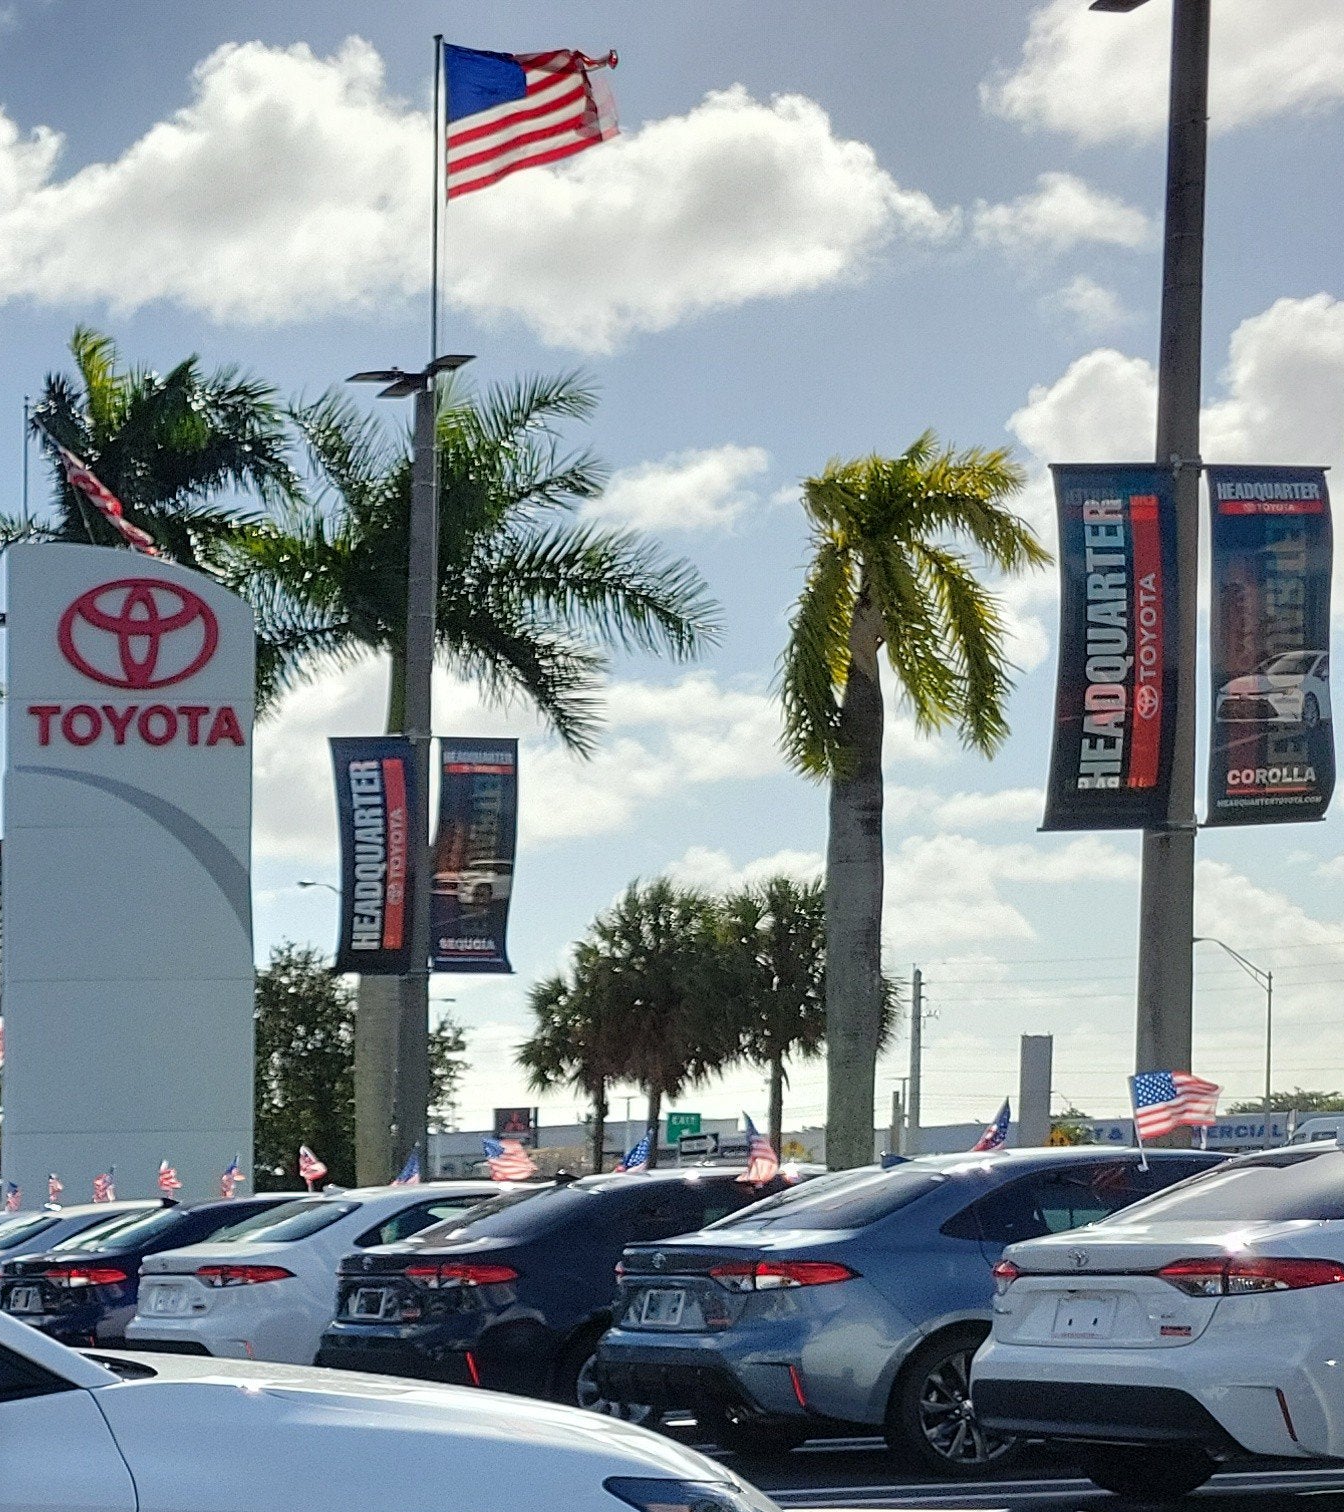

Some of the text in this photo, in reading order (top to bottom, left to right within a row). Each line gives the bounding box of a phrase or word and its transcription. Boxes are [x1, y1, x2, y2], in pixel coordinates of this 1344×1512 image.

[1216, 482, 1320, 501] HEADQUARTER
[1077, 498, 1134, 790] HEADQUARTER
[1137, 572, 1158, 683] TOYOTA
[27, 704, 246, 747] TOYOTA
[1227, 767, 1316, 785] COROLLA
[349, 760, 387, 950] HEADQUARTER
[388, 807, 407, 880] TOYOTA
